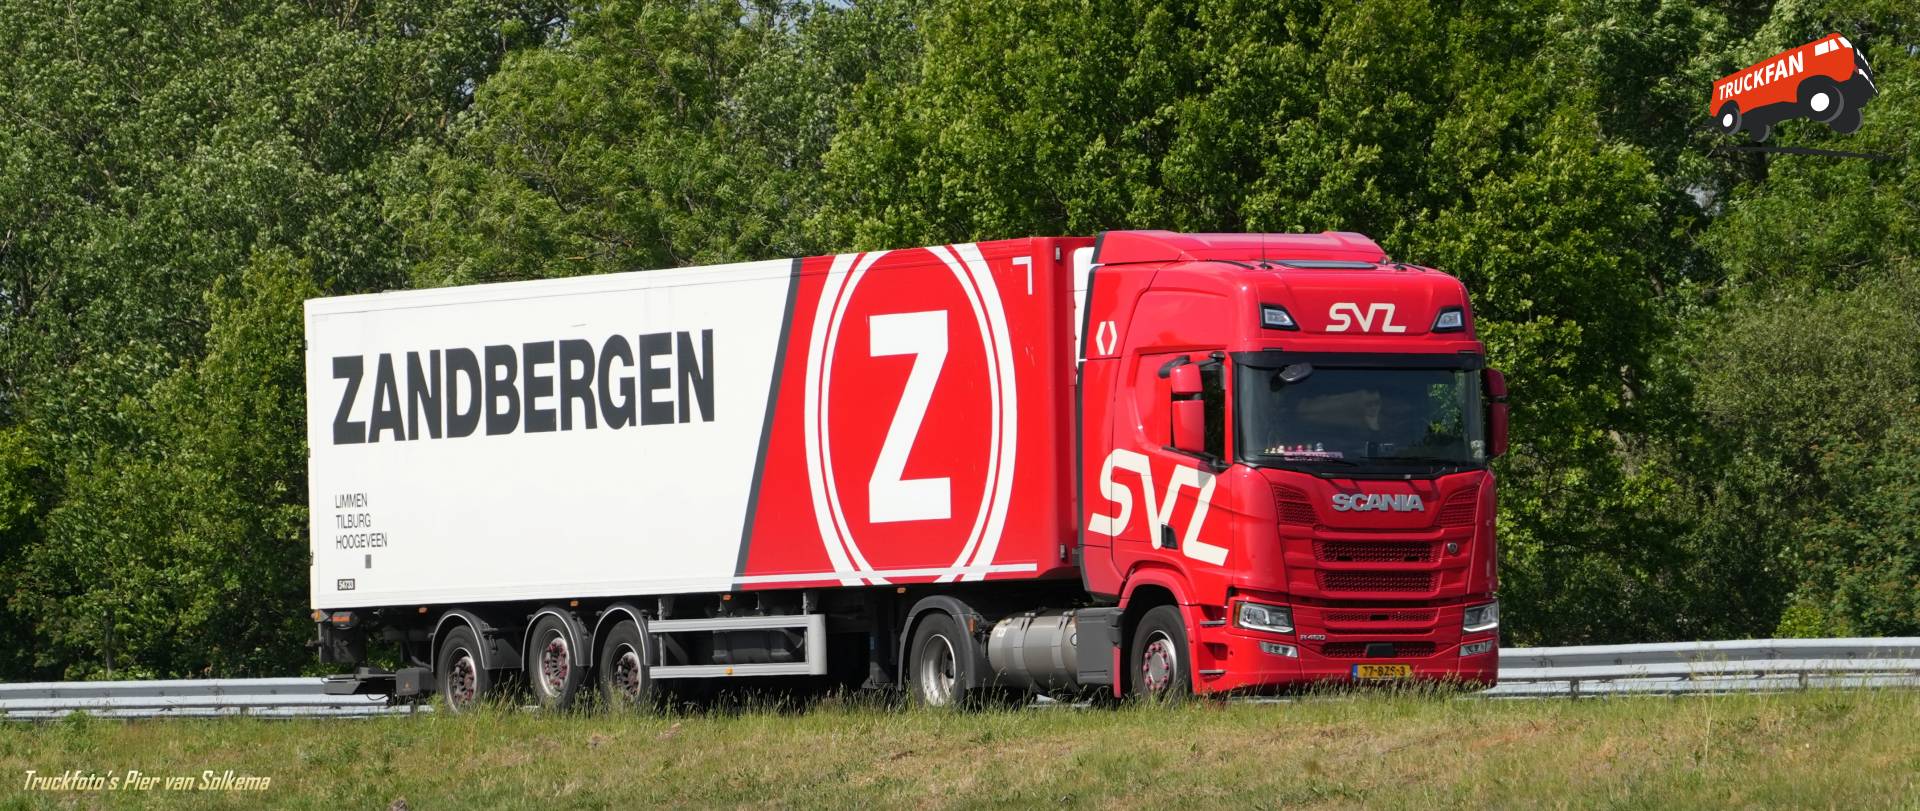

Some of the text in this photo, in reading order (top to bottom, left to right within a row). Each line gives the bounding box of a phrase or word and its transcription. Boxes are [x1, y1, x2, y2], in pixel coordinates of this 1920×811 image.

[1325, 302, 1407, 333] SVZ
[332, 328, 715, 445] ZANDBERGEN
[869, 310, 951, 523] Z
[335, 492, 368, 509] LIMMEN
[1088, 448, 1229, 567] SVZ
[1332, 493, 1425, 512] SCANIA
[335, 513, 371, 529] TILBURG
[335, 532, 388, 550] HOOGEVEEN
